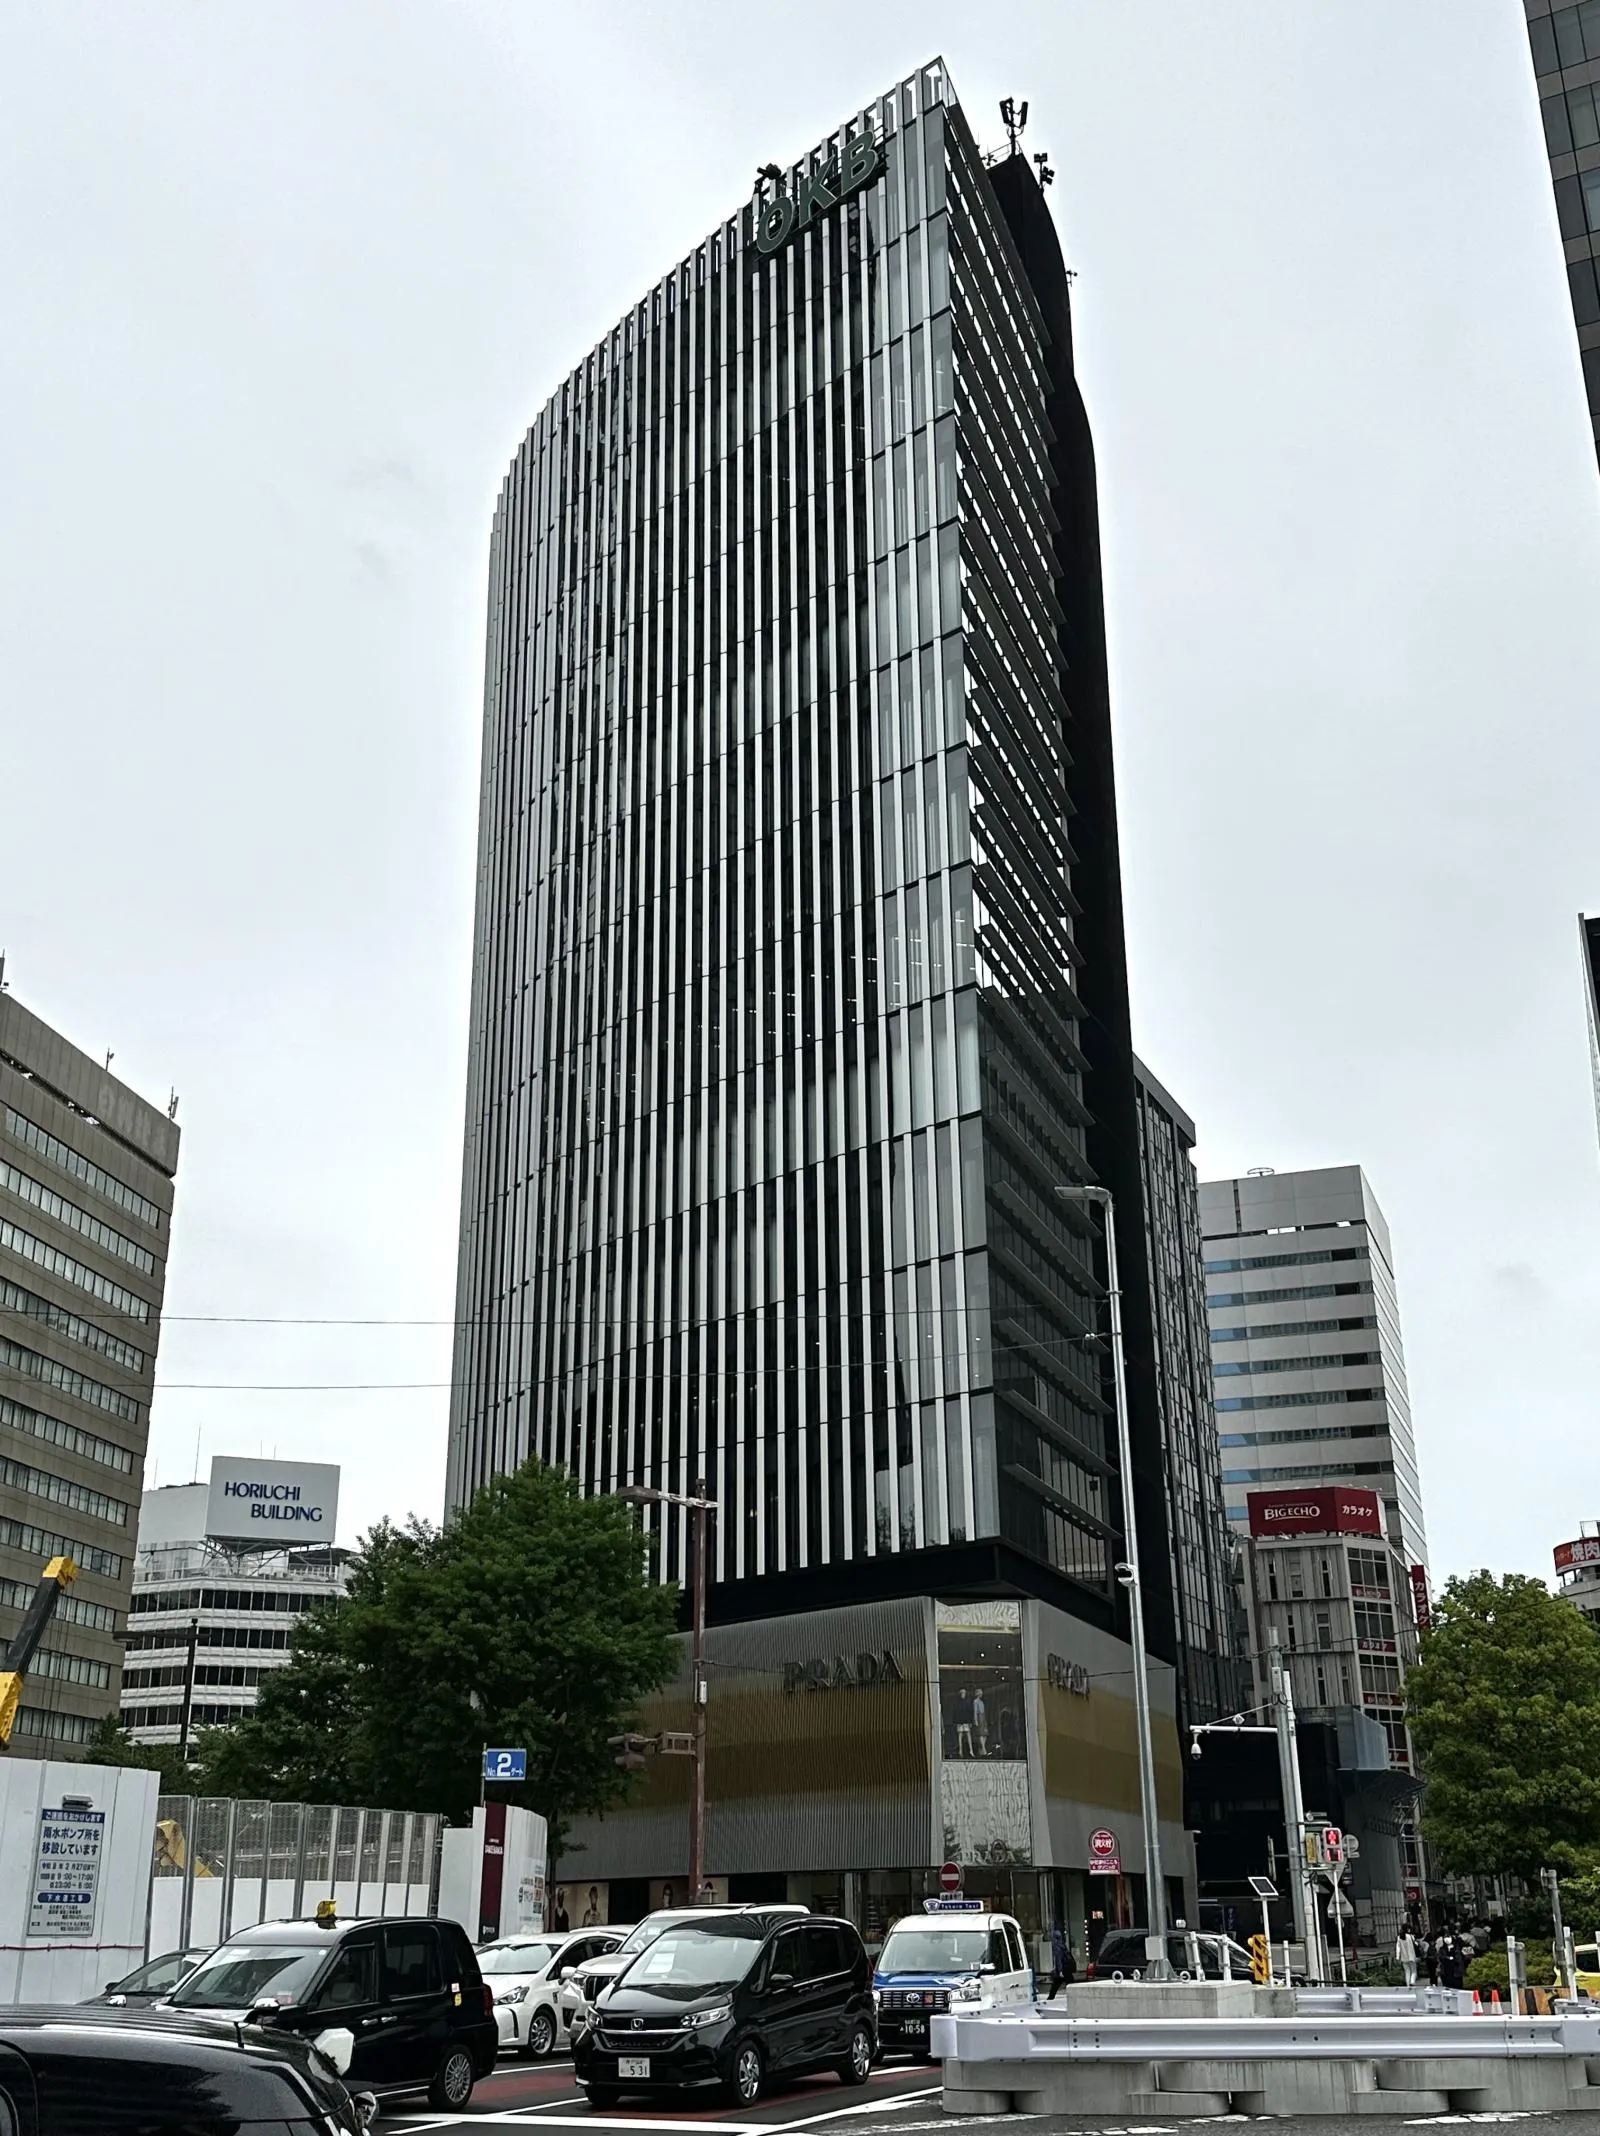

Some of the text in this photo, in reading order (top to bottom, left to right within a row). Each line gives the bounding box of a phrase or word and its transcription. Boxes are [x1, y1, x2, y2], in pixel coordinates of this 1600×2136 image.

[756, 130, 879, 253] OKB
[224, 1481, 301, 1501] HORIUCHI
[251, 1503, 323, 1522] BUILDING
[1342, 1505, 1373, 1517] カラオケ
[1571, 1541, 1600, 1562] 焼肉
[1414, 1581, 1431, 1630] カラオケ
[784, 1650, 904, 1694] PRADA
[43, 1826, 100, 1841] 雨水ポンプ所を
[41, 1842, 99, 1856] 移設しています
